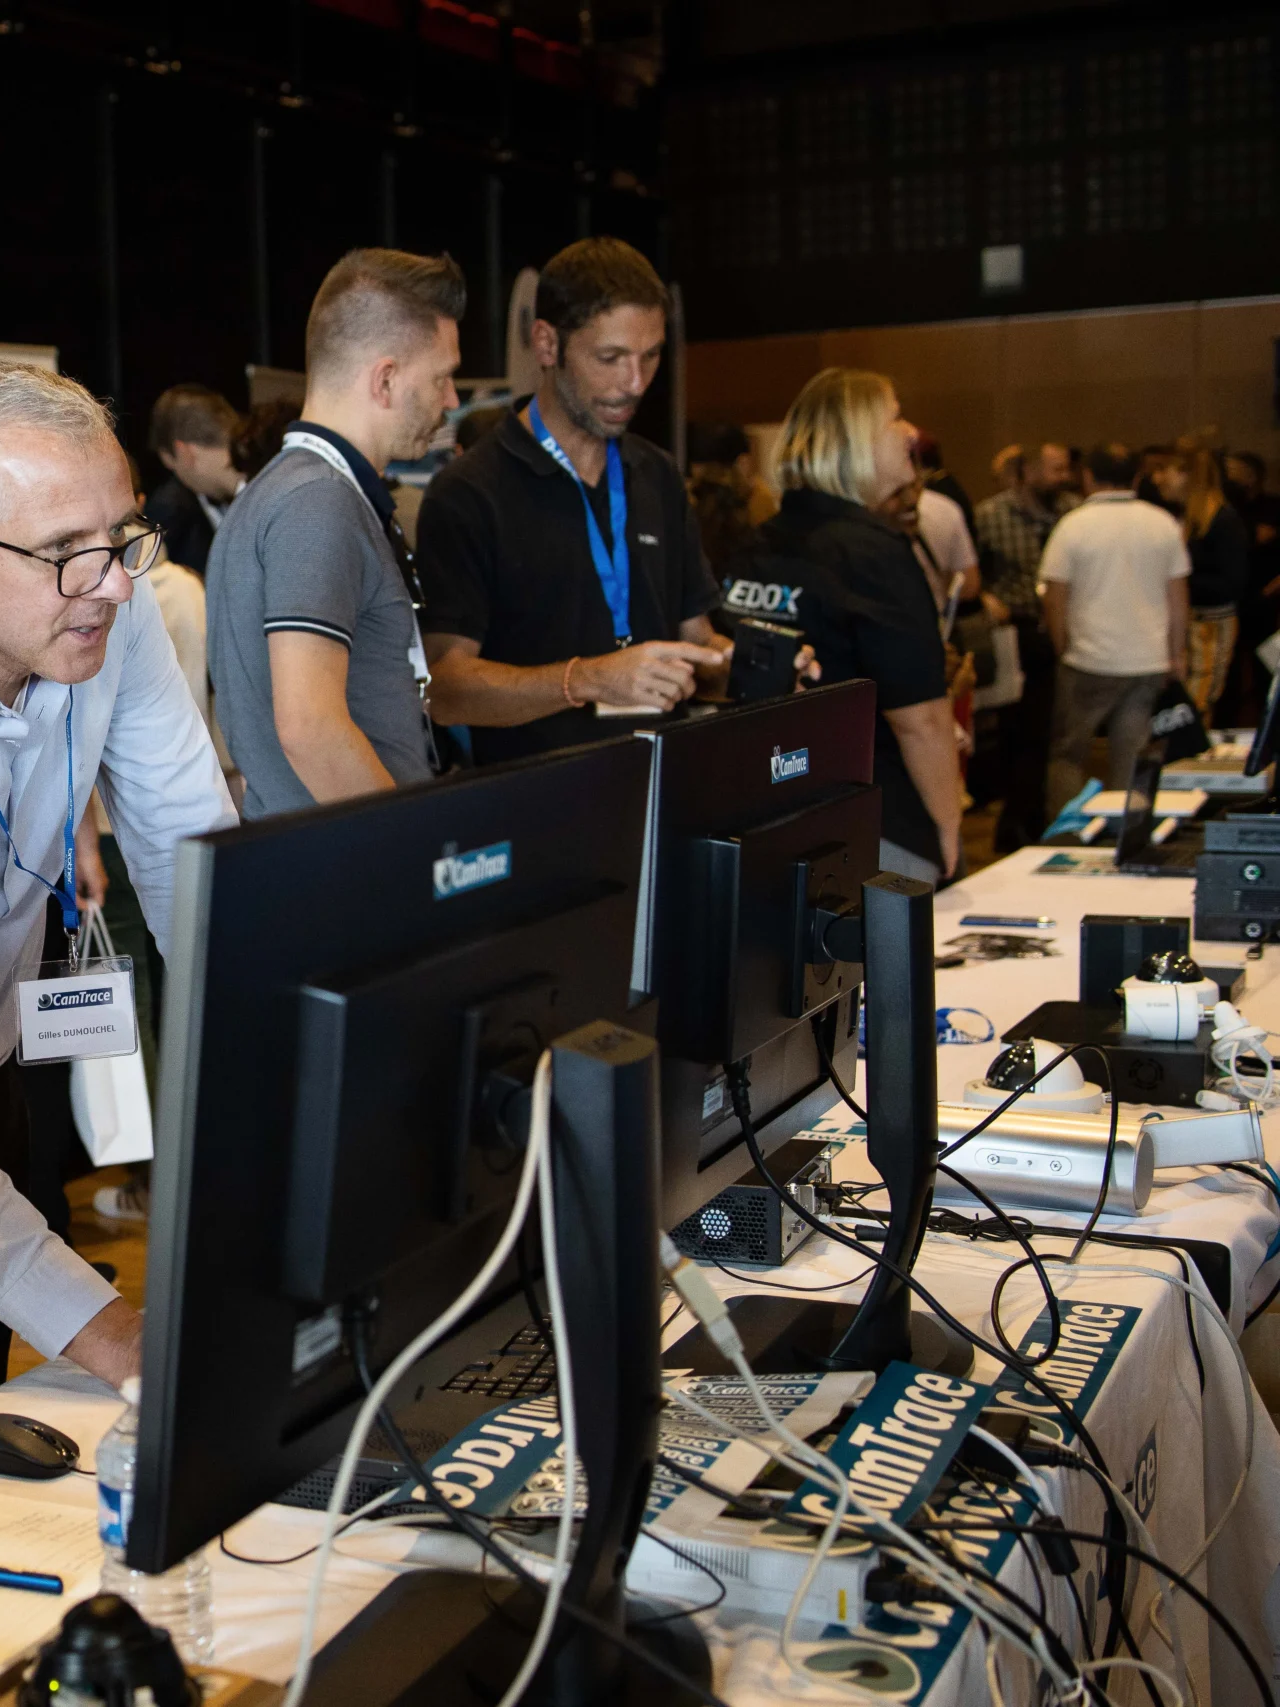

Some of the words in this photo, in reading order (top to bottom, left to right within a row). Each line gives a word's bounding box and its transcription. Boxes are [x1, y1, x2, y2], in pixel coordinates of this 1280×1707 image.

[53, 991, 111, 1006] CamTrace
[38, 1031, 62, 1040] Gilles
[63, 1024, 116, 1038] DUMOUCHEL
[800, 1373, 976, 1523] CamTrace
